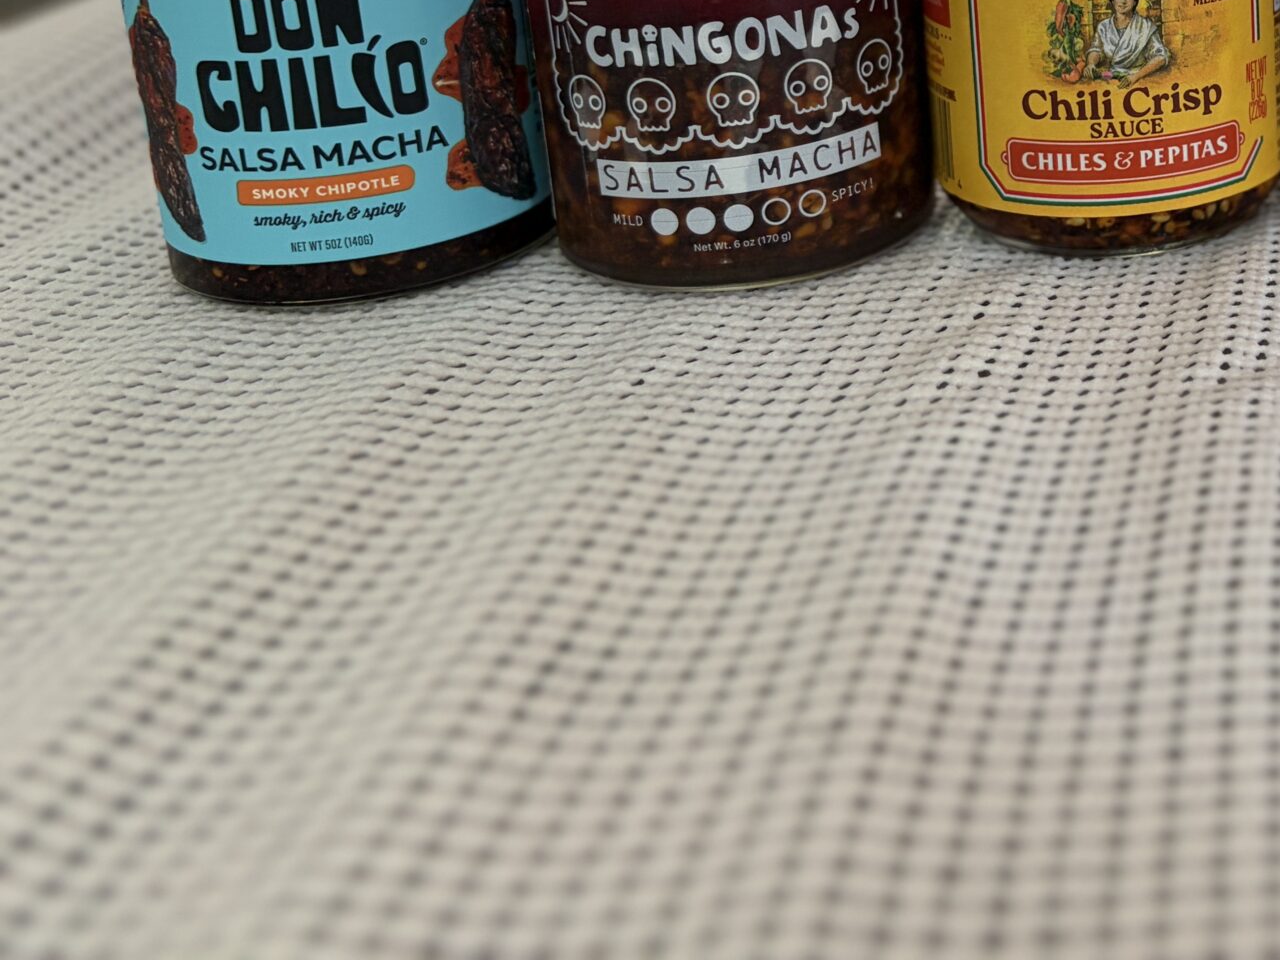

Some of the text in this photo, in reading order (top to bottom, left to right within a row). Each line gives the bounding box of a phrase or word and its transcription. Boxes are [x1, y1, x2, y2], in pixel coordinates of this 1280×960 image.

[1021, 82, 1222, 122] Chili Crisp
[1090, 117, 1164, 139] SAUCE
[200, 125, 449, 173] SALSA MACHA
[603, 131, 878, 192] SALSA MACHA
[1021, 135, 1229, 172] CHILES & PEPITAS
[252, 175, 400, 200] SMOKY CHIPOTLE
[831, 178, 875, 203] SPICY!
[254, 201, 406, 230] smoky, rich & spicy
[613, 213, 643, 227] MILD
[291, 241, 307, 253] NET
[308, 239, 323, 251] WT
[693, 231, 792, 252] Net Wt. 6 oz (170 g)
